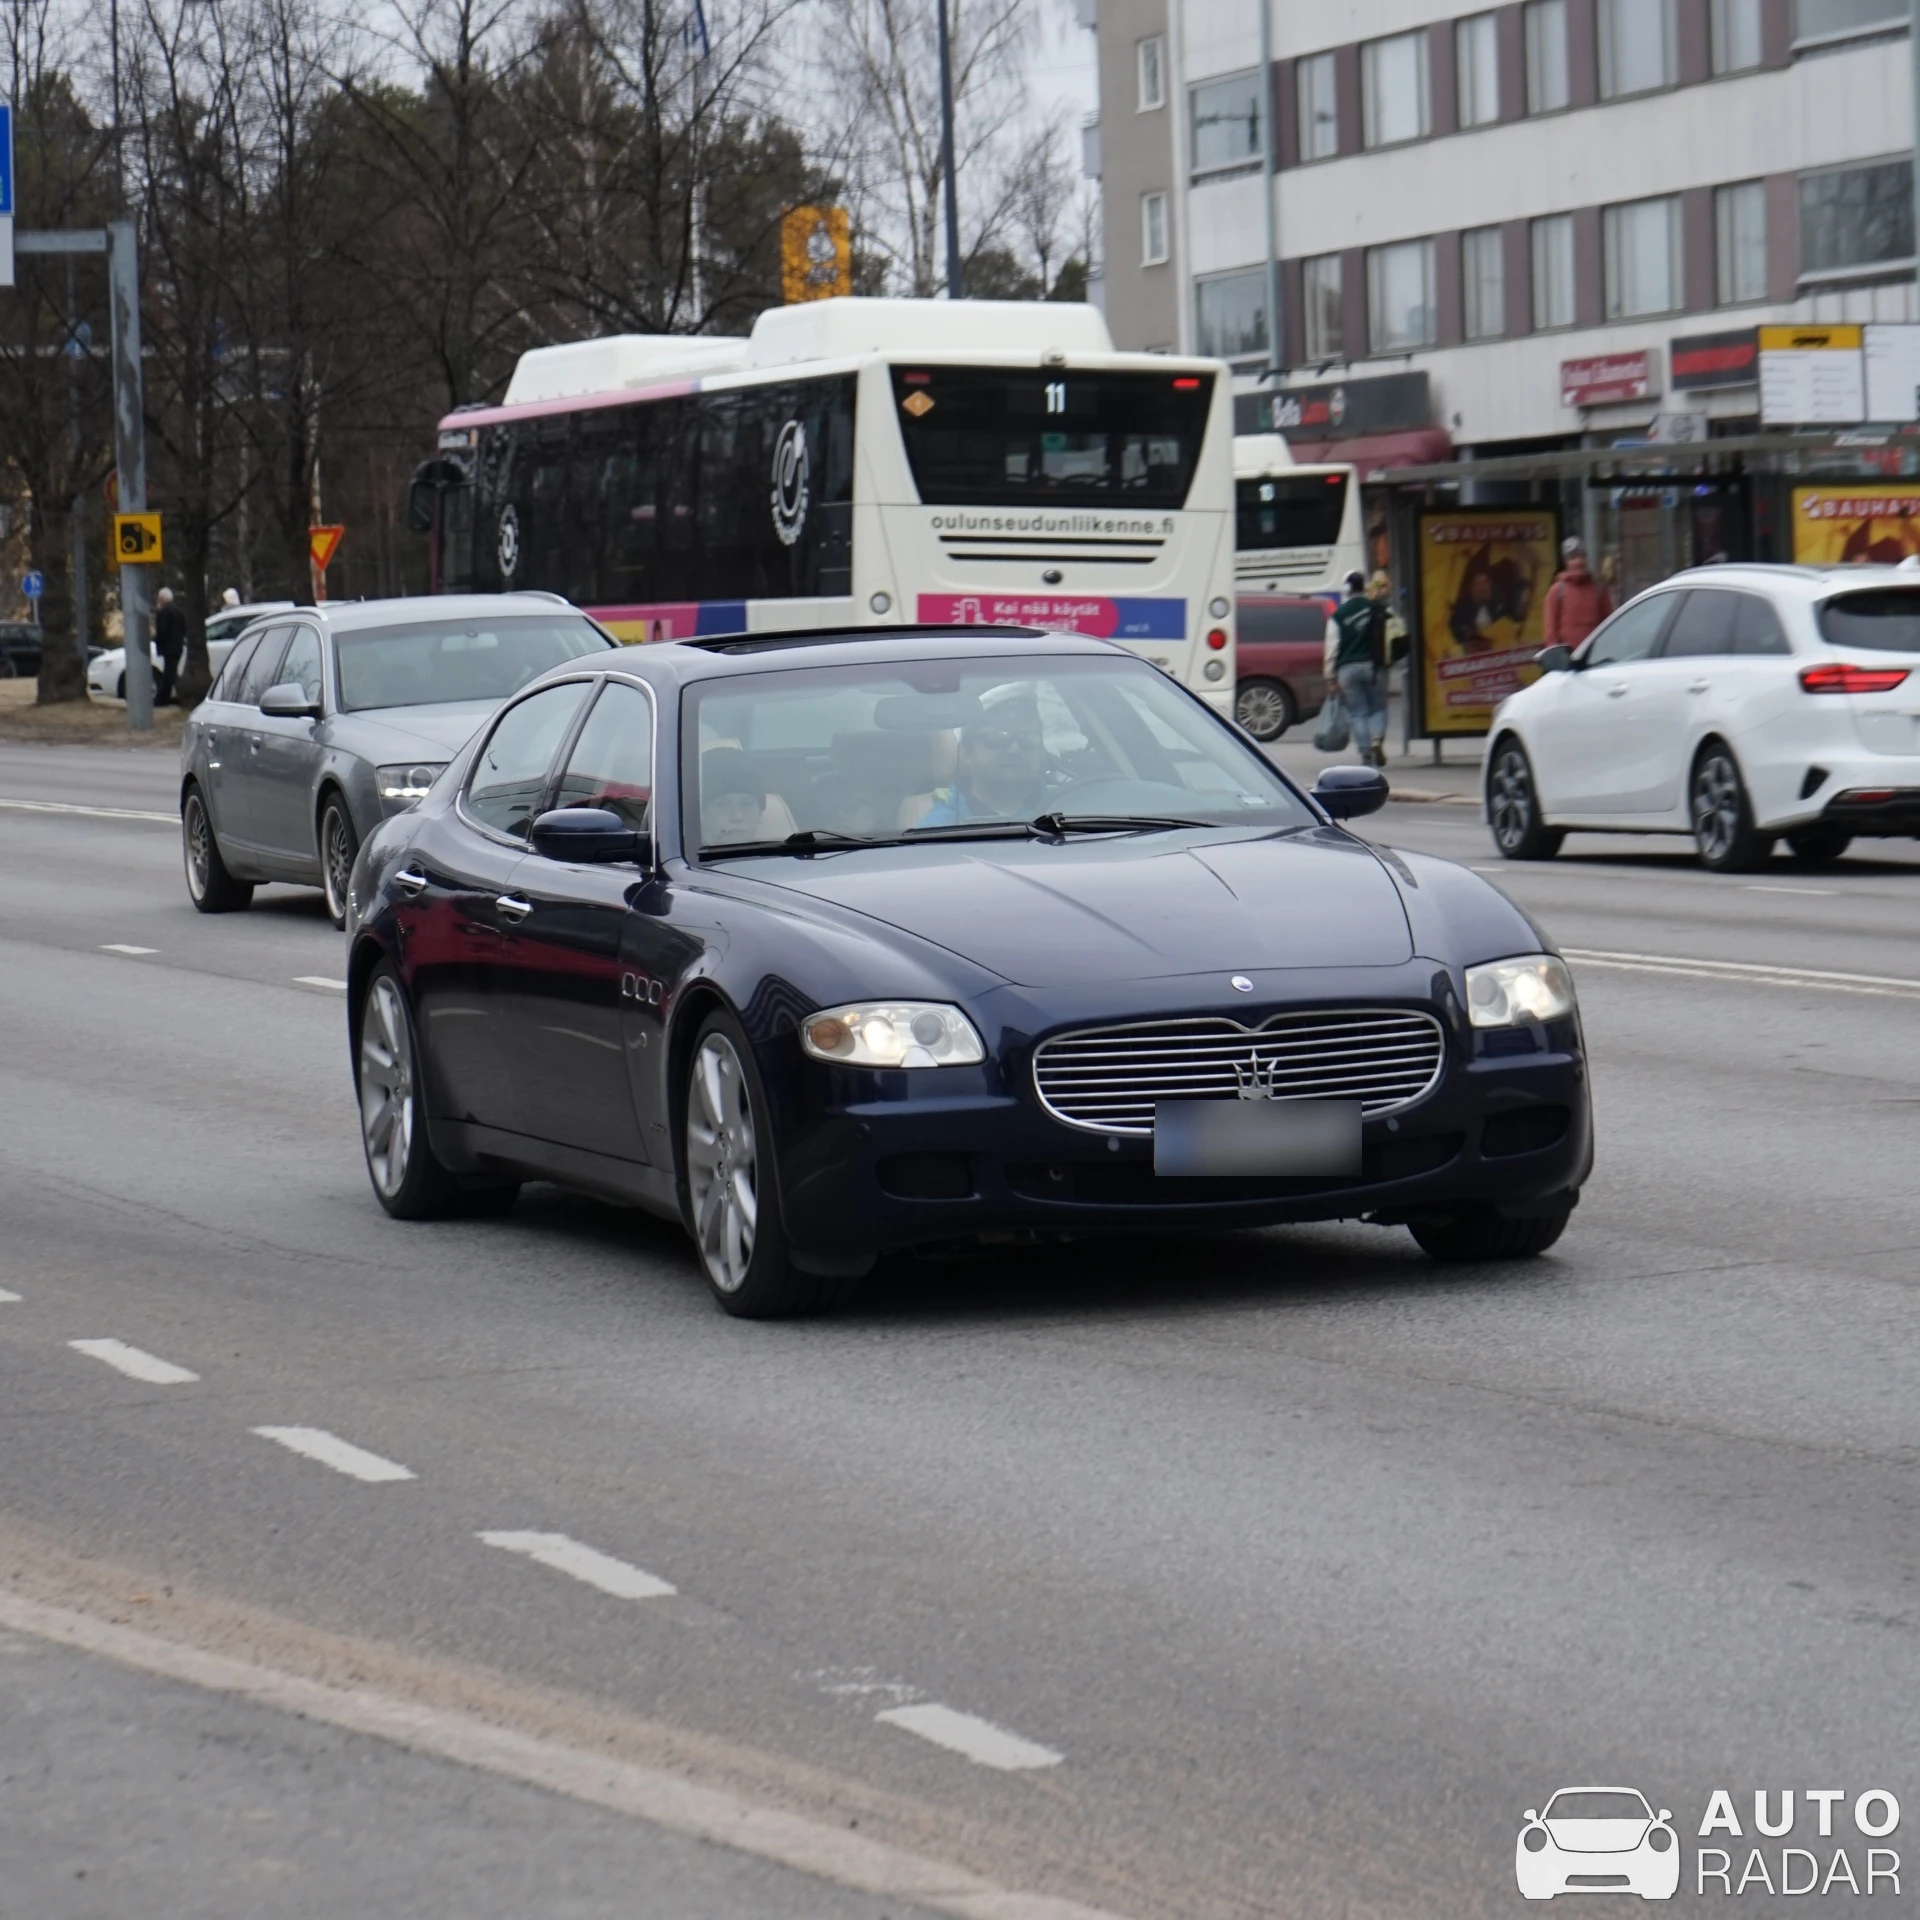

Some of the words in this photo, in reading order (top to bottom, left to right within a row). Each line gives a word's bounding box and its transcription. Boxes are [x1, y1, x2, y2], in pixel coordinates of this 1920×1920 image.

[1045, 382, 1065, 413] 11
[1823, 498, 1920, 517] BAUHAU
[931, 512, 1176, 535] oulunseudunliikenne.fi
[993, 601, 1018, 615] Kai
